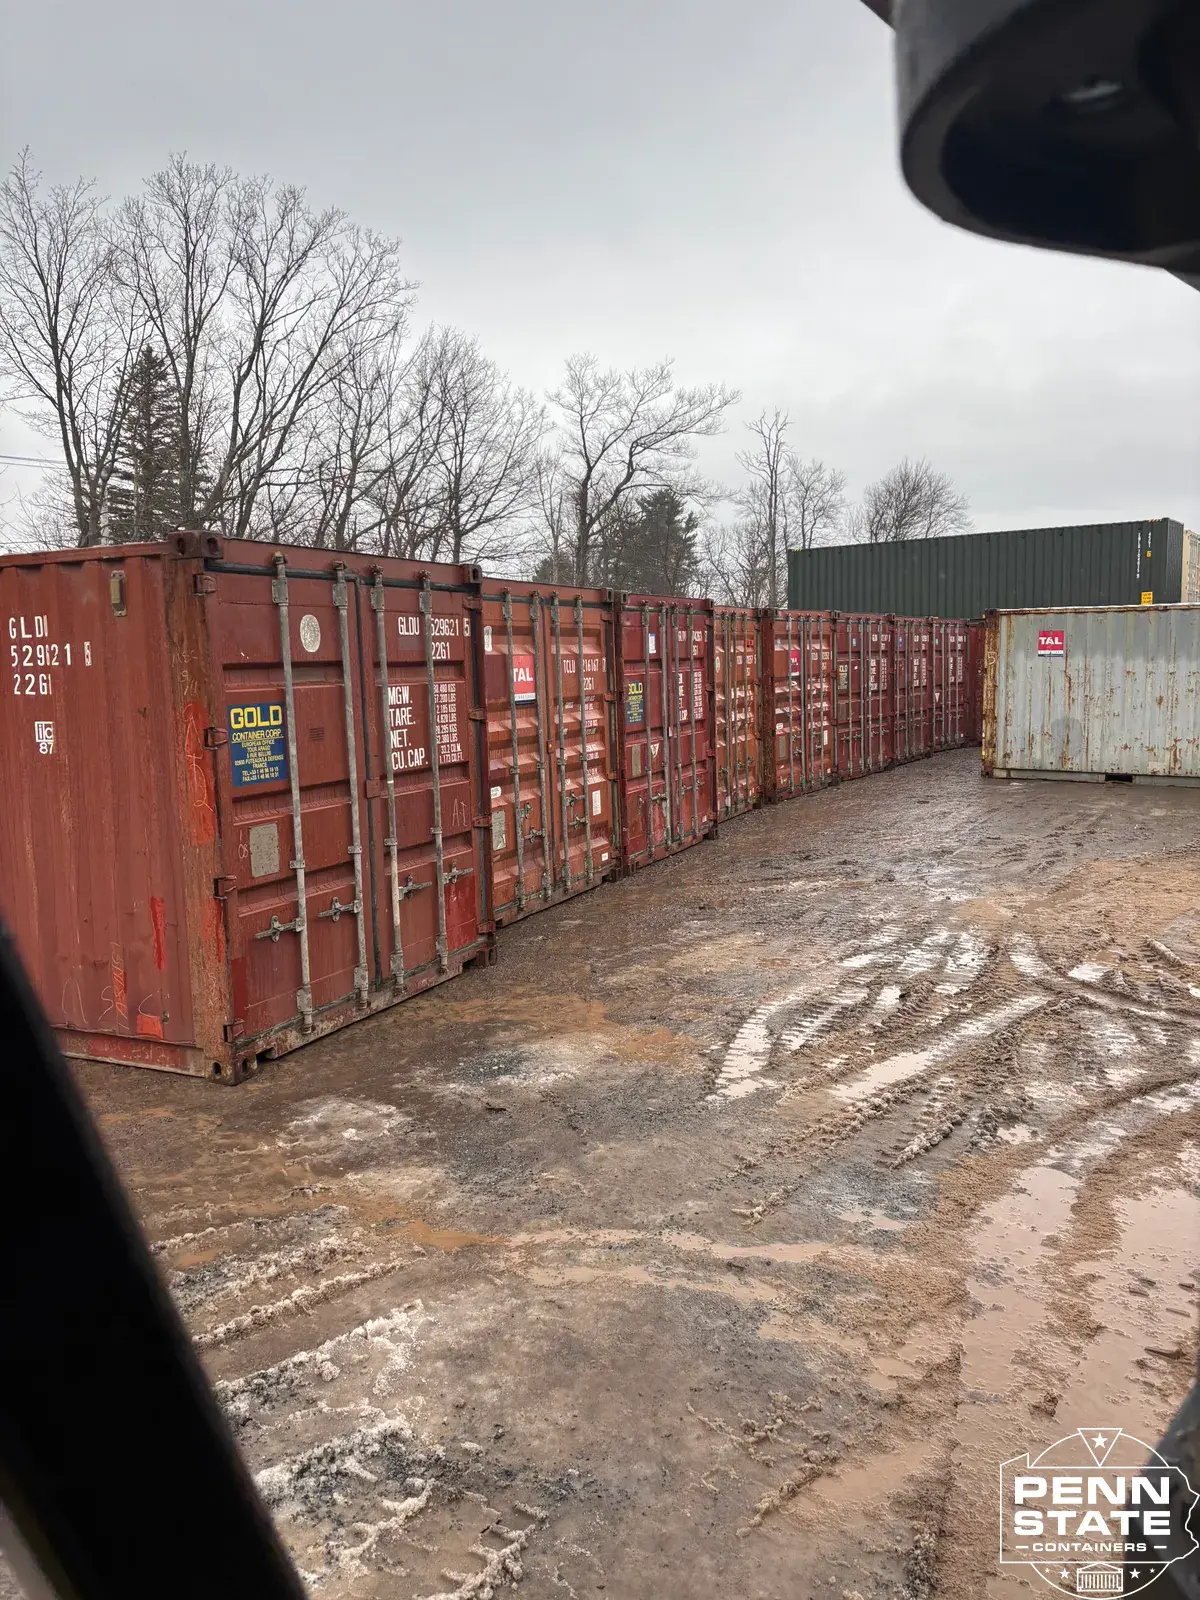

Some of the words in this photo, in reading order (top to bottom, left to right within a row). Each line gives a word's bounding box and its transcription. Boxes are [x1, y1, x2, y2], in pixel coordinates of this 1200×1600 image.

[398, 616, 420, 635] GLDU
[463, 617, 471, 636] 5
[432, 641, 451, 659] 22G1
[1039, 636, 1063, 645] TAL
[513, 667, 534, 683] TAL
[387, 685, 413, 705] MGW.
[230, 705, 283, 729] GOLD
[389, 706, 416, 727] TARE.
[232, 731, 265, 742] CONTAINER
[390, 728, 412, 749] NET.
